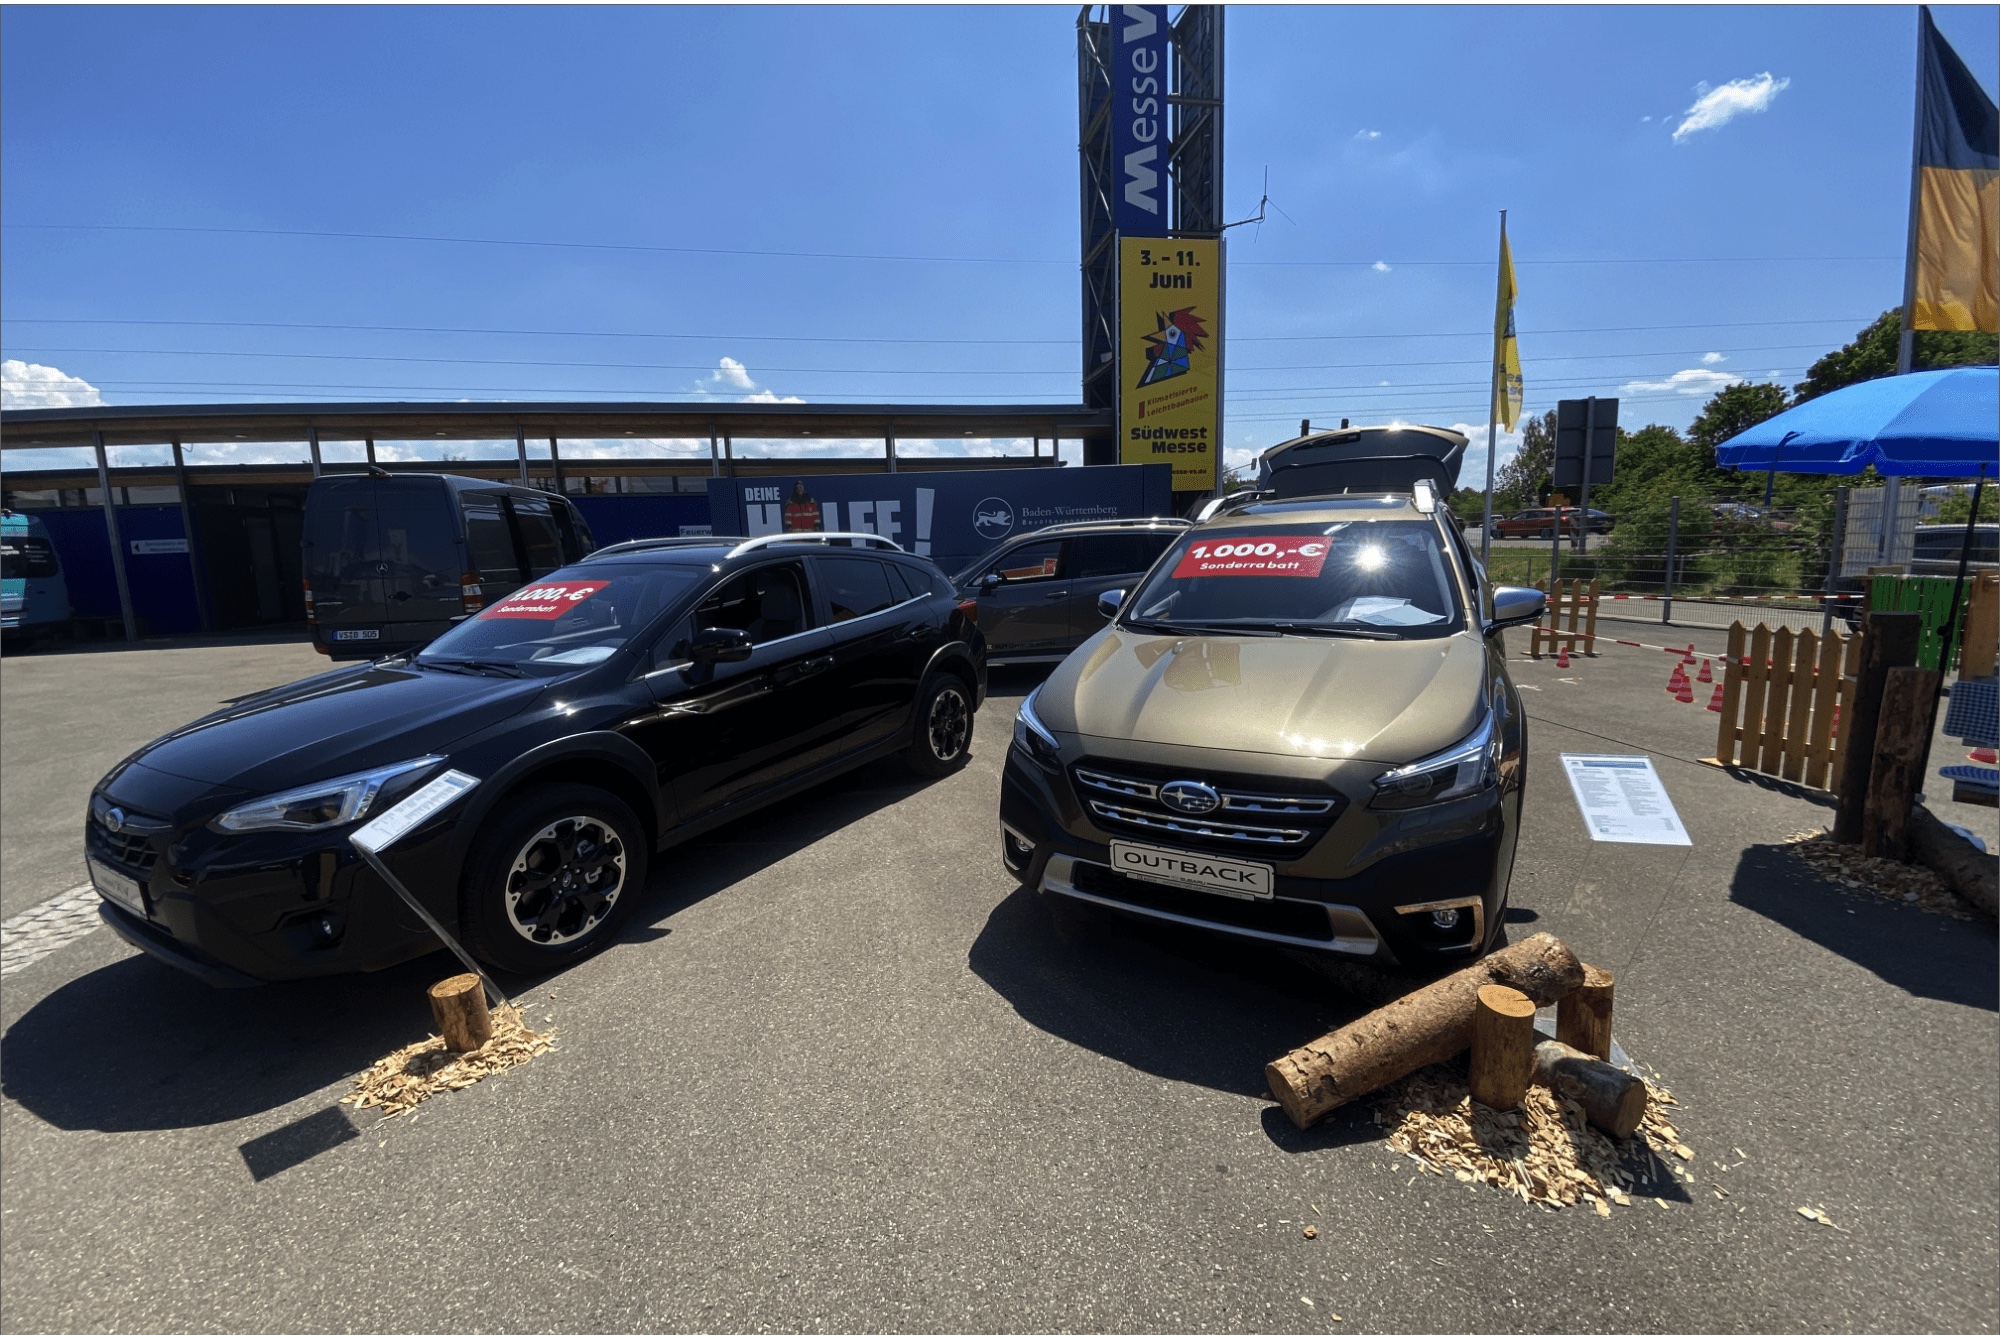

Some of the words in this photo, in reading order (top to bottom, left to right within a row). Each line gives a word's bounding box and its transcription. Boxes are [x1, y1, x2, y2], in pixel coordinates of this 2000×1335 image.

[1140, 250, 1158, 266] 3.
[1176, 250, 1201, 267] 11.
[1149, 271, 1192, 289] Juni
[1131, 425, 1207, 440] Südwest
[1152, 441, 1206, 453] Messe
[744, 486, 781, 501] DEINE
[1021, 504, 1118, 518] Baden-Württemberg
[1124, 852, 1257, 885] OUTBACK
